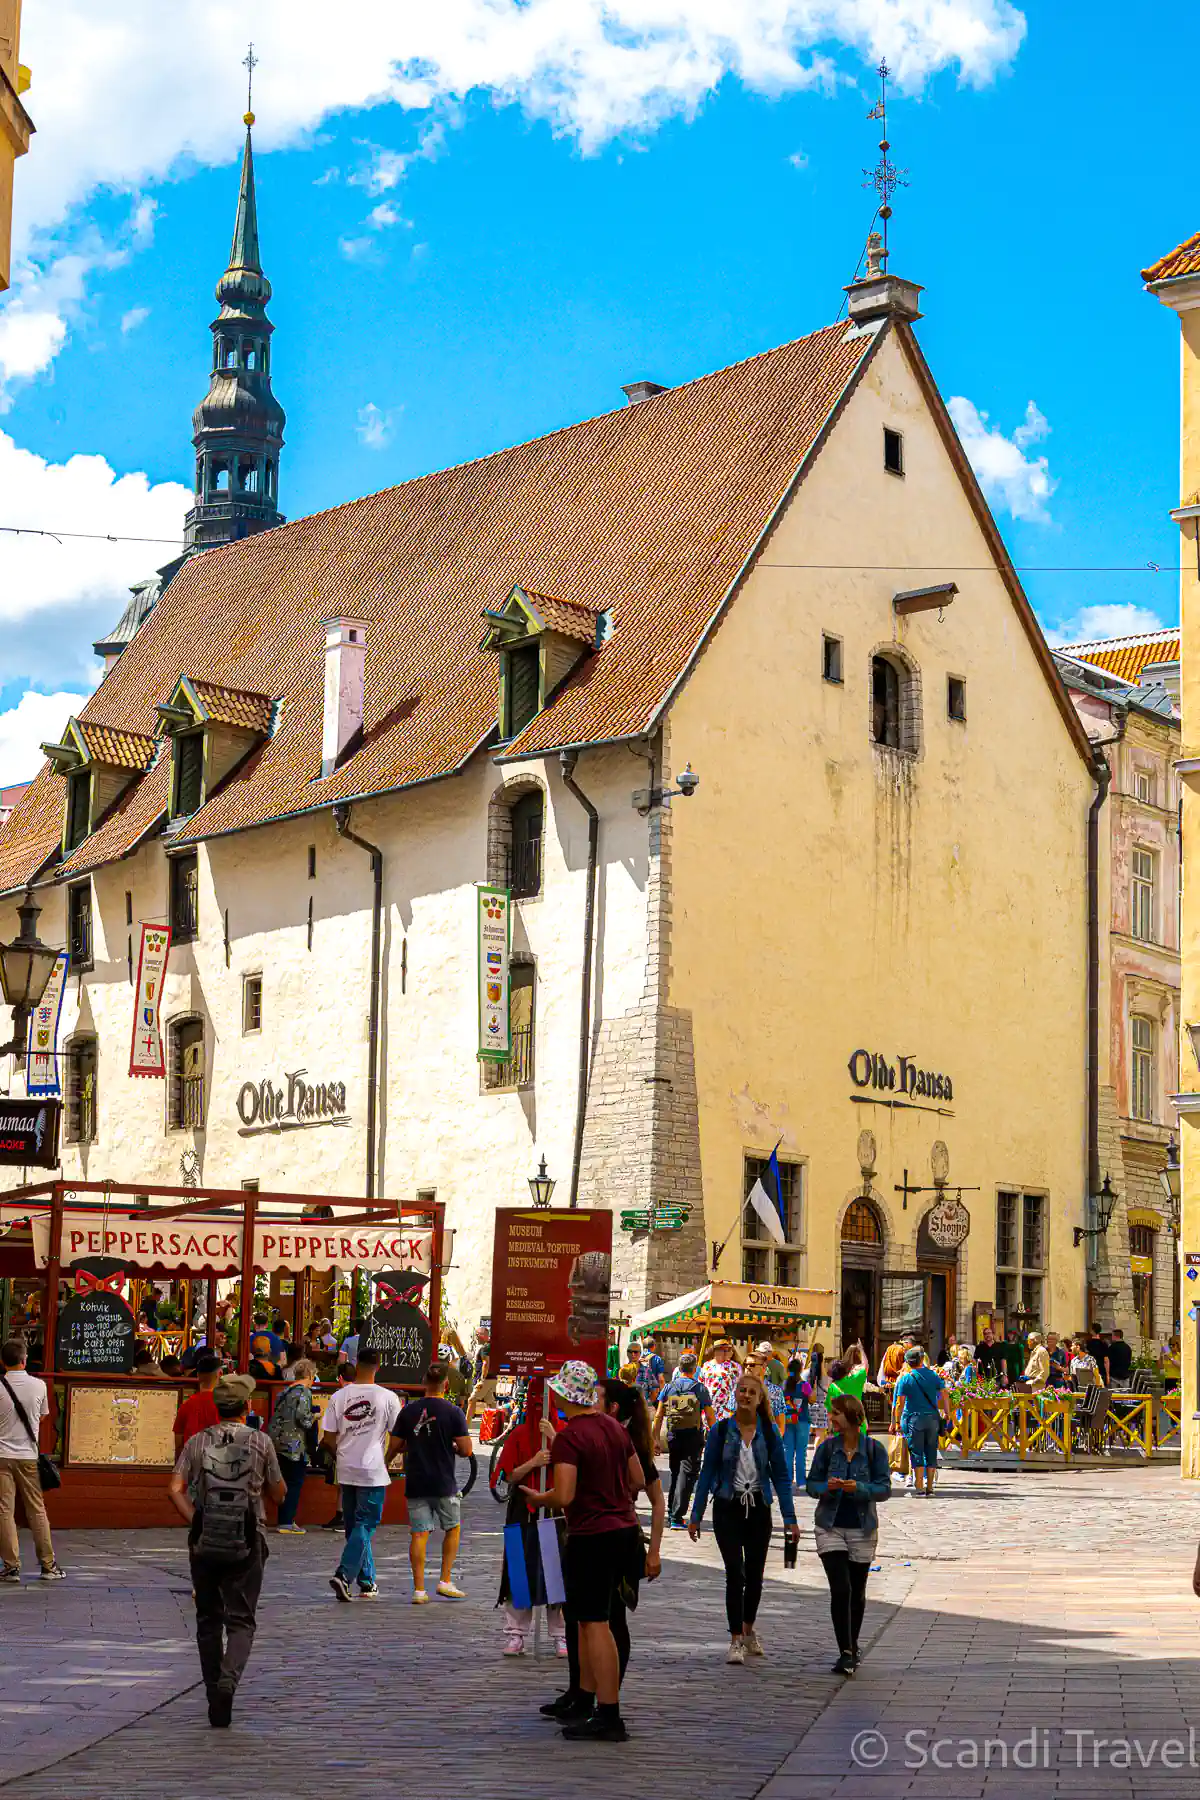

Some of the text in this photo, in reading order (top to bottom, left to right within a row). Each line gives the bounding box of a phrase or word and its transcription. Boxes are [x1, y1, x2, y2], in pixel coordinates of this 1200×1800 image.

[847, 1049, 896, 1091] Olde
[236, 1079, 283, 1126] Olde
[508, 1225, 543, 1237] MUSEUM
[930, 1215, 967, 1237] Shoppe
[70, 1230, 239, 1258] PEPPERSACK
[262, 1235, 423, 1260] PEPPERSACK
[508, 1241, 581, 1254] MEDIEVAL TORTURE
[507, 1257, 559, 1269] INSTRUMENTS
[749, 1289, 771, 1305] Olde
